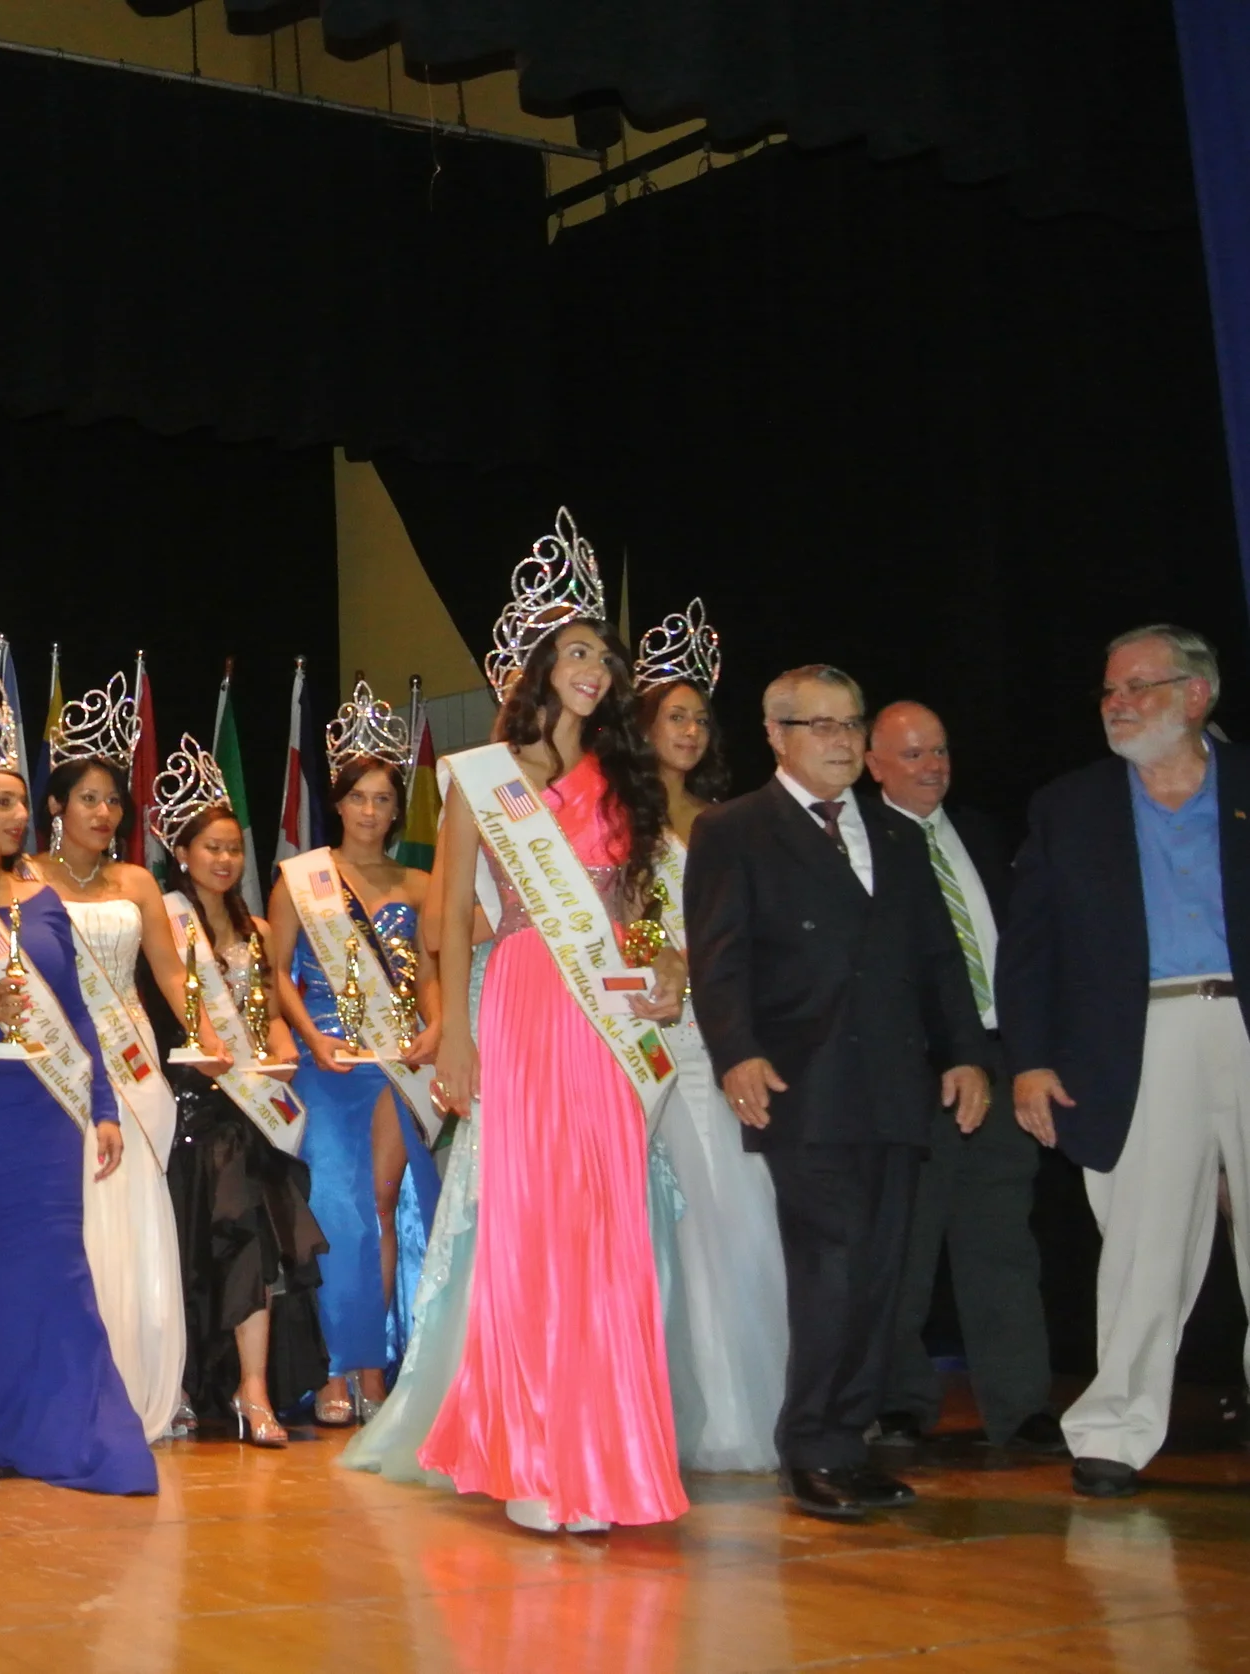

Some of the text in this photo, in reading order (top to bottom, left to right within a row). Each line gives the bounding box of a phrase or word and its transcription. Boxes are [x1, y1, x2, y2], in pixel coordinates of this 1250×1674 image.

[478, 809, 549, 916] Anniversary
[541, 916, 562, 939] Of
[527, 837, 607, 969] Queen Of The
